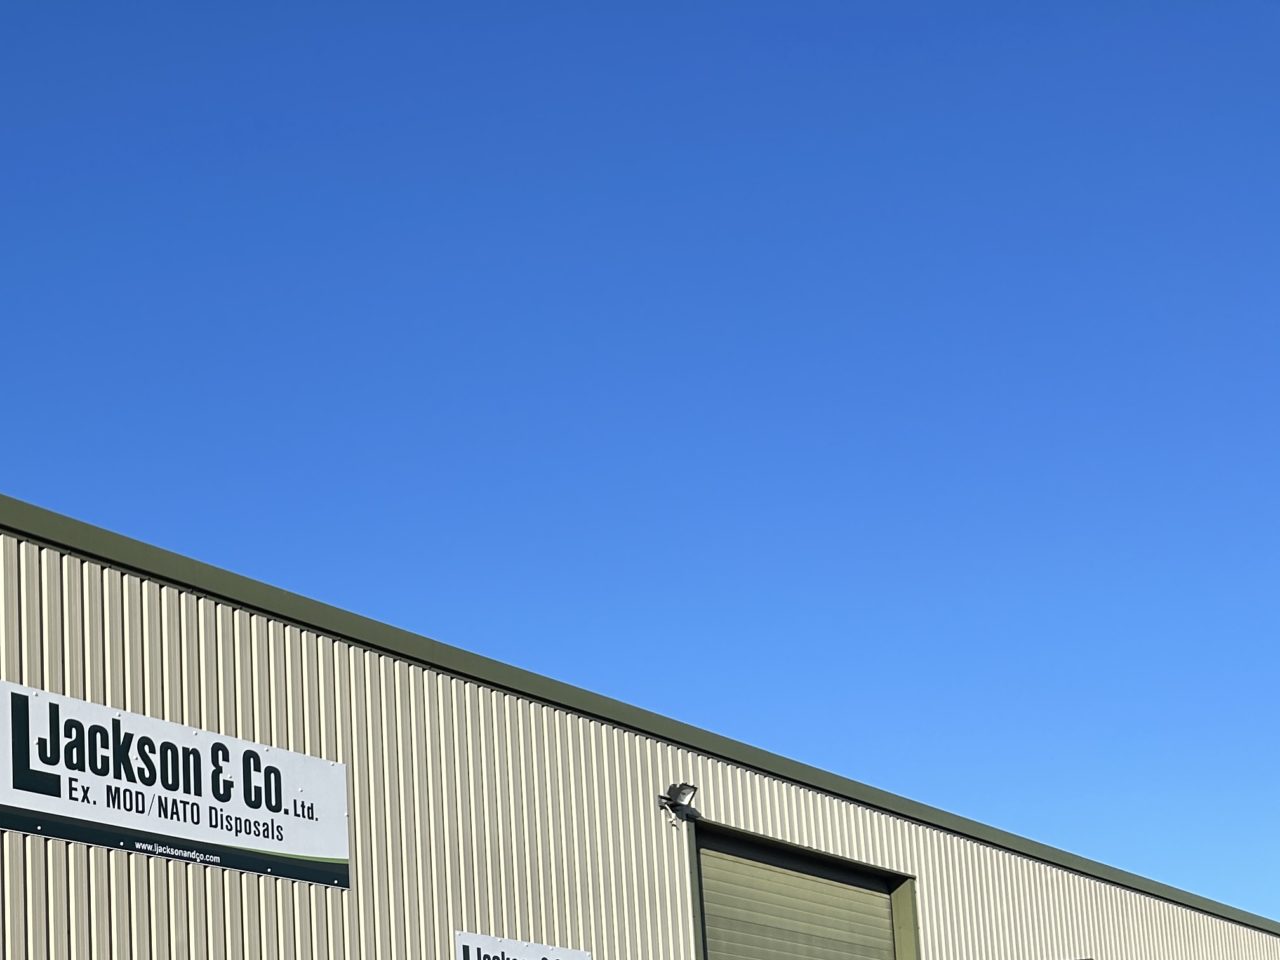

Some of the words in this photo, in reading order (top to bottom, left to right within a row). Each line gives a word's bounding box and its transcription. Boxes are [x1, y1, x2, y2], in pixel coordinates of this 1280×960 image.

[68, 777, 97, 804] Ex.
[106, 784, 201, 825] MOD/NATO
[208, 805, 284, 842] Disposals
[210, 741, 234, 803] &
[242, 748, 289, 815] Co.
[293, 799, 319, 822] Ltd.
[134, 841, 221, 863] www.ljacksonandco.com
